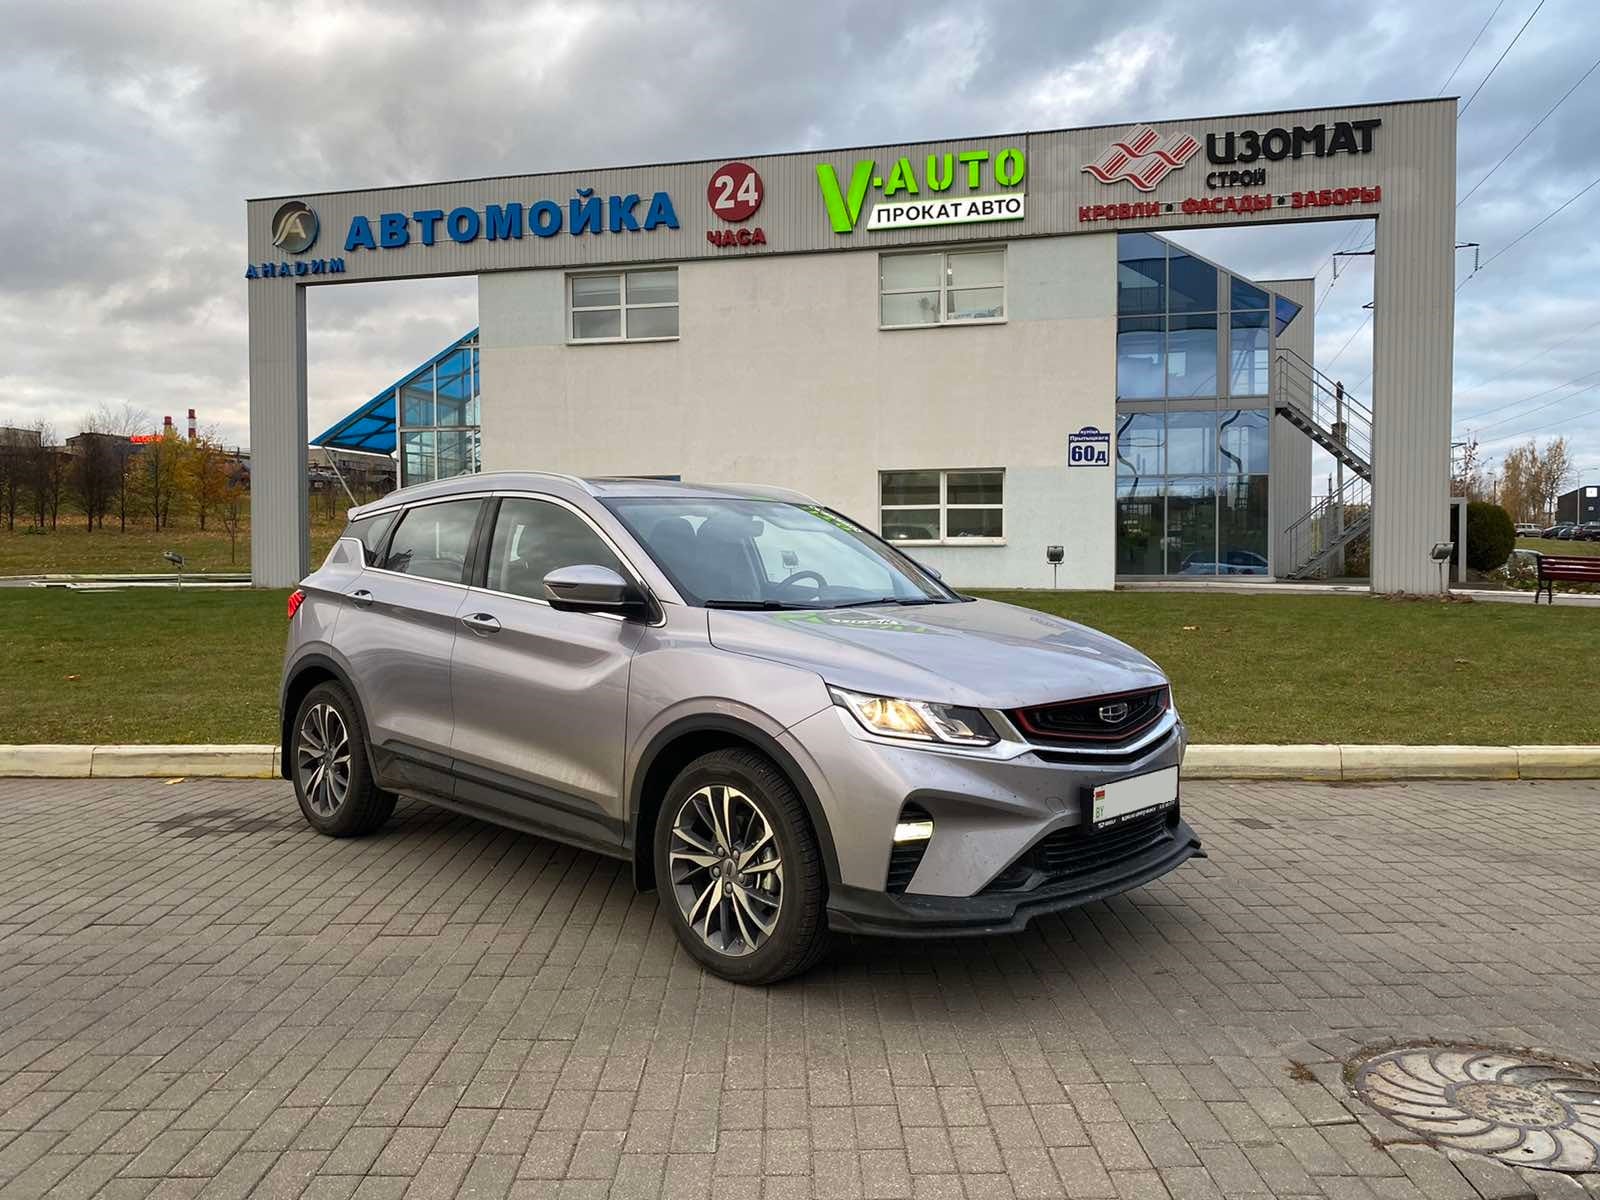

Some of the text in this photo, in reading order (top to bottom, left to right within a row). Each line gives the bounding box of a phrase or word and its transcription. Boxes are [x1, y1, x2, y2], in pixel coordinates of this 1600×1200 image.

[714, 172, 759, 210] 24
[815, 148, 1026, 234] V-AUTO
[1206, 167, 1266, 190] СТРОЙ
[877, 198, 1022, 223] ПРОКАТ АВТО
[1078, 185, 1382, 223] КРОВЛИ ФАСАДЫ ЗАБОРЫ
[344, 187, 681, 253] АВТОМОЙКА
[706, 227, 767, 248] ЧАСА
[246, 256, 346, 279] АНАДИМ
